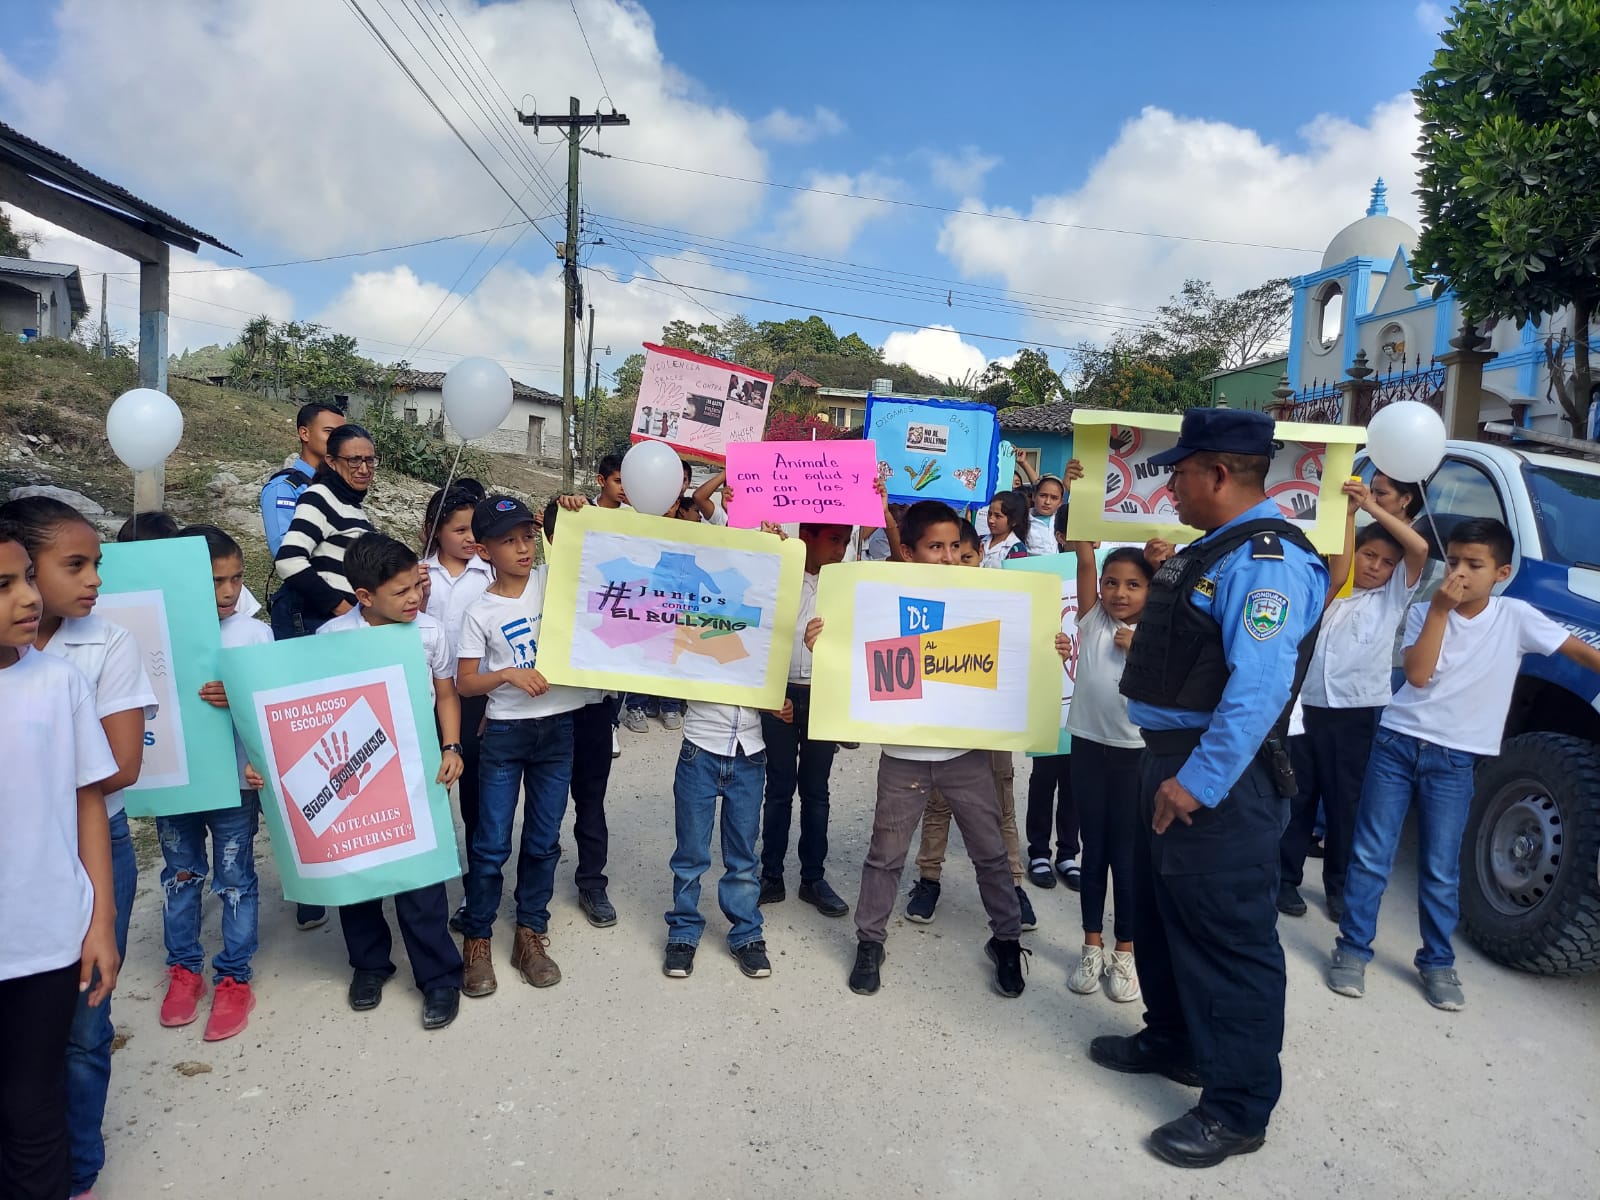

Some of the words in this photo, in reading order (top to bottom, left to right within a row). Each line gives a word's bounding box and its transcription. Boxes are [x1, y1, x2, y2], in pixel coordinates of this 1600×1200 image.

[696, 381, 722, 391] CONTRA
[737, 473, 760, 481] con
[805, 470, 842, 480] salud
[852, 473, 859, 484] y
[1134, 462, 1159, 480] NO
[817, 482, 844, 492] las
[772, 494, 846, 514] Drogas.
[661, 602, 700, 612] contra
[1251, 593, 1286, 605] HONDURAS
[611, 608, 640, 621] EL
[906, 605, 930, 631] Di
[924, 640, 937, 650] AL
[874, 647, 916, 692] NO
[271, 710, 283, 722] DI
[284, 705, 300, 719] NO
[302, 702, 315, 715] AL
[315, 696, 348, 713] ACOSO
[290, 714, 335, 732] ESCOLAR
[302, 785, 334, 822] STOP
[329, 728, 388, 793] BULLYING
[331, 820, 347, 834] NO
[347, 816, 362, 830] TE
[362, 807, 401, 826] CALLES
[341, 838, 352, 853] SI
[353, 828, 394, 848] FUERAS
